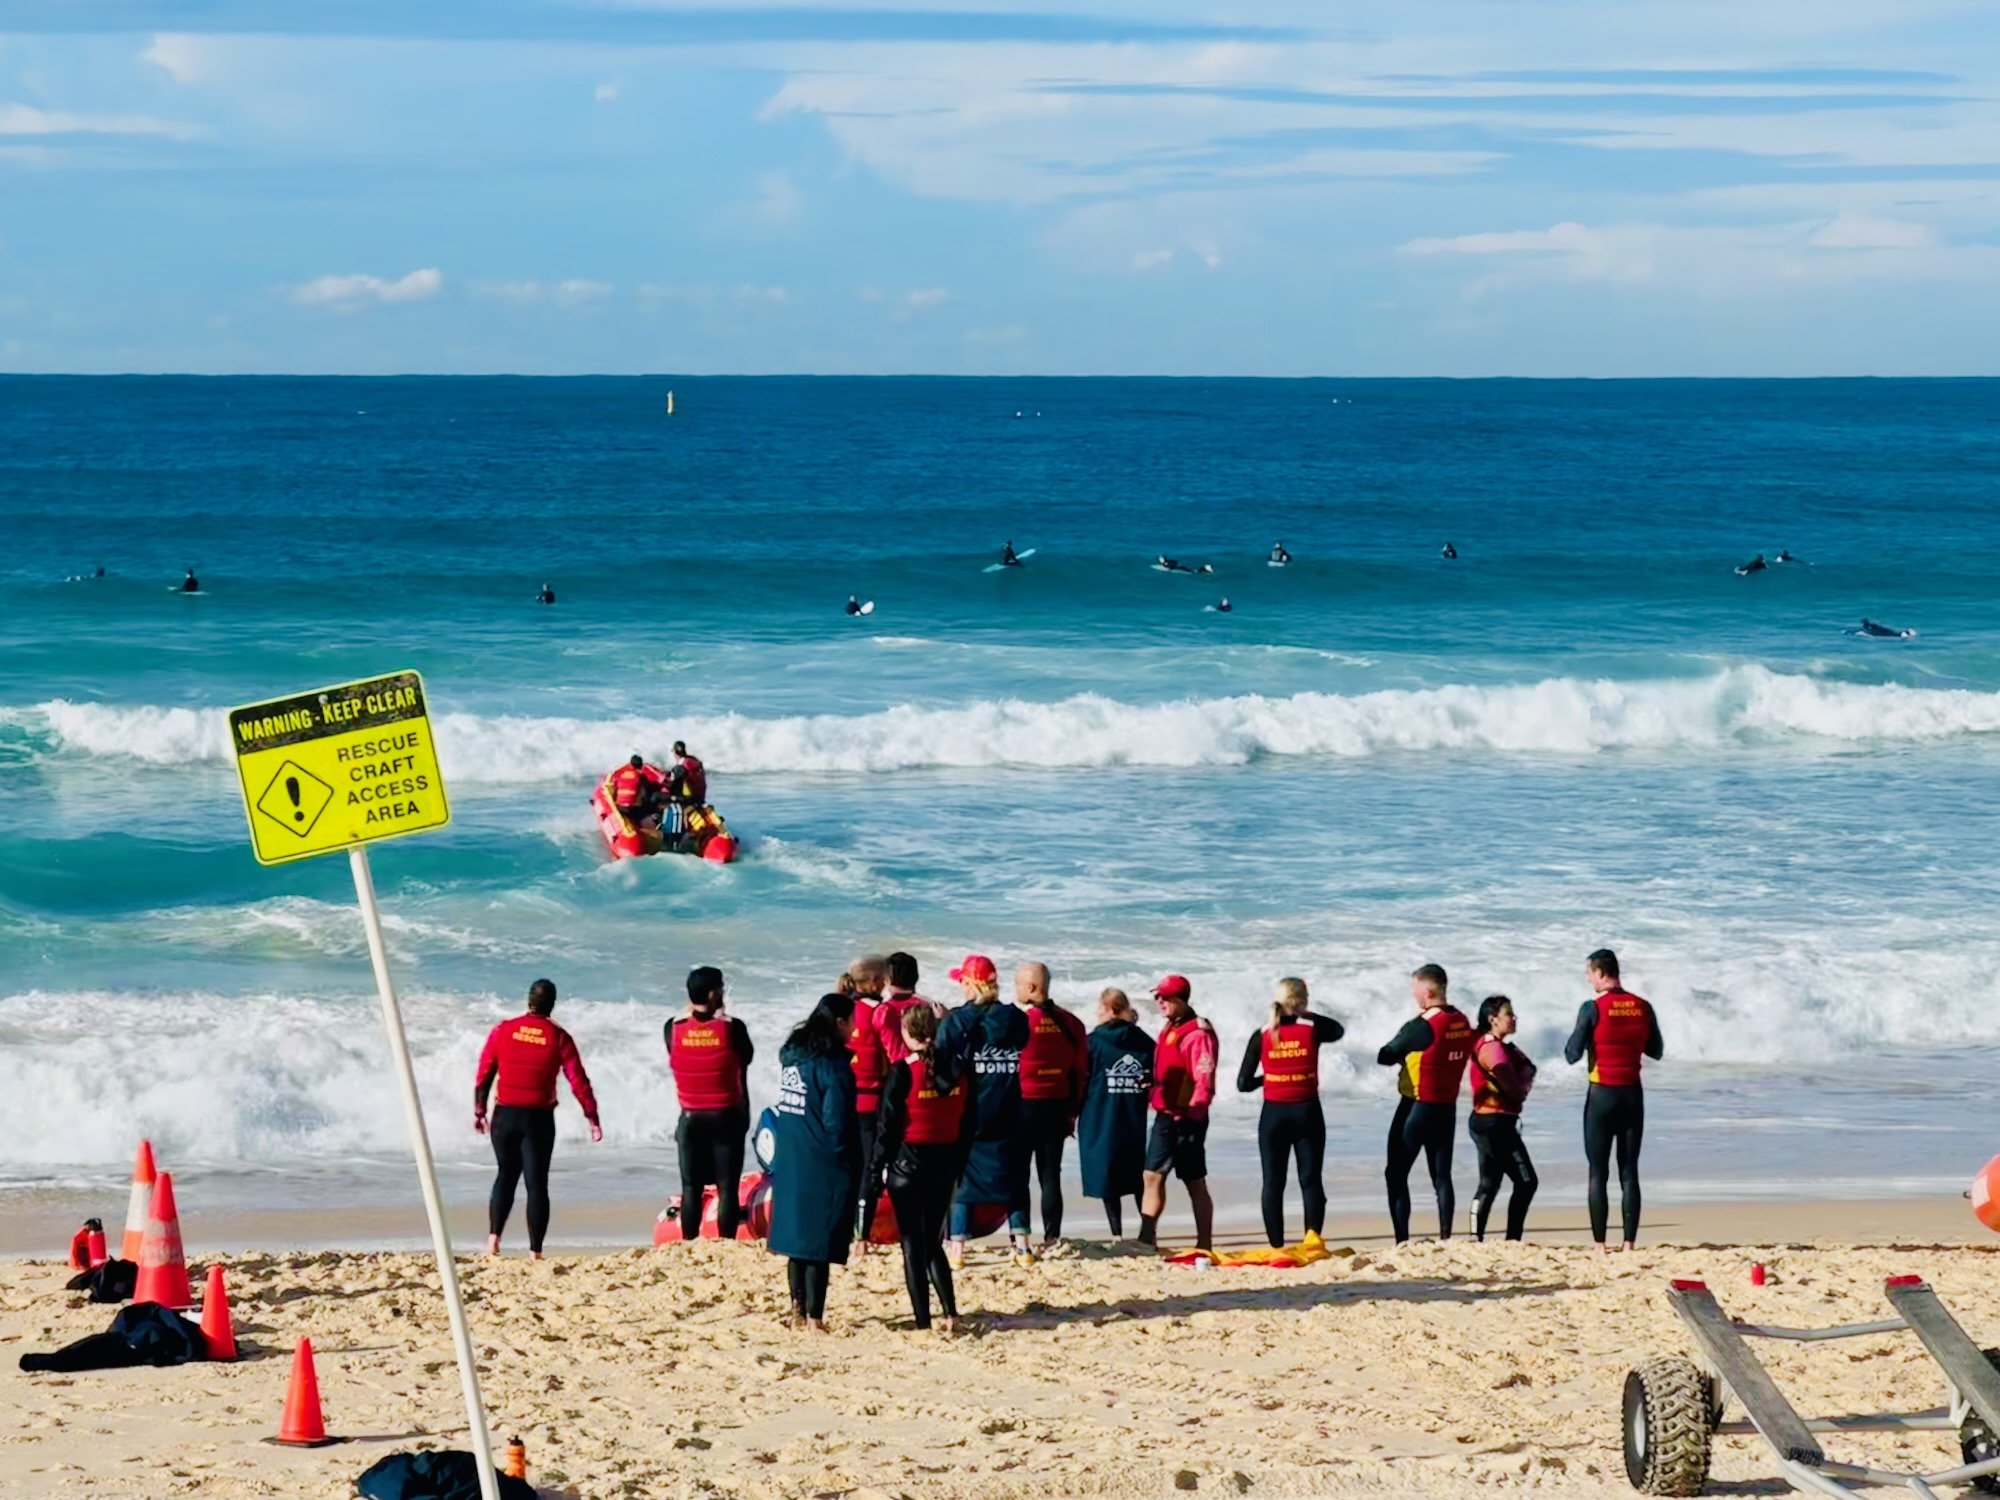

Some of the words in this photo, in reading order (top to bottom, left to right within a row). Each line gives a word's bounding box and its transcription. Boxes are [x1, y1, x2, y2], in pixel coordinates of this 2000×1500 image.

[238, 709, 313, 741] WARNING
[322, 699, 362, 724] KEEP
[366, 686, 417, 714] CLEAR
[337, 732, 420, 762] RESCUE
[350, 755, 415, 782] CRAFT
[347, 775, 429, 805] ACCESS
[365, 800, 420, 824] AREA
[1613, 1000, 1635, 1009] SURF
[1608, 1008, 1643, 1017] RESCUE
[519, 1025, 543, 1036] SURF
[687, 1029, 714, 1038] SURF
[512, 1031, 547, 1046] RESCUE
[681, 1037, 720, 1047] RESCUE
[1268, 1048, 1308, 1059] RESCUE
